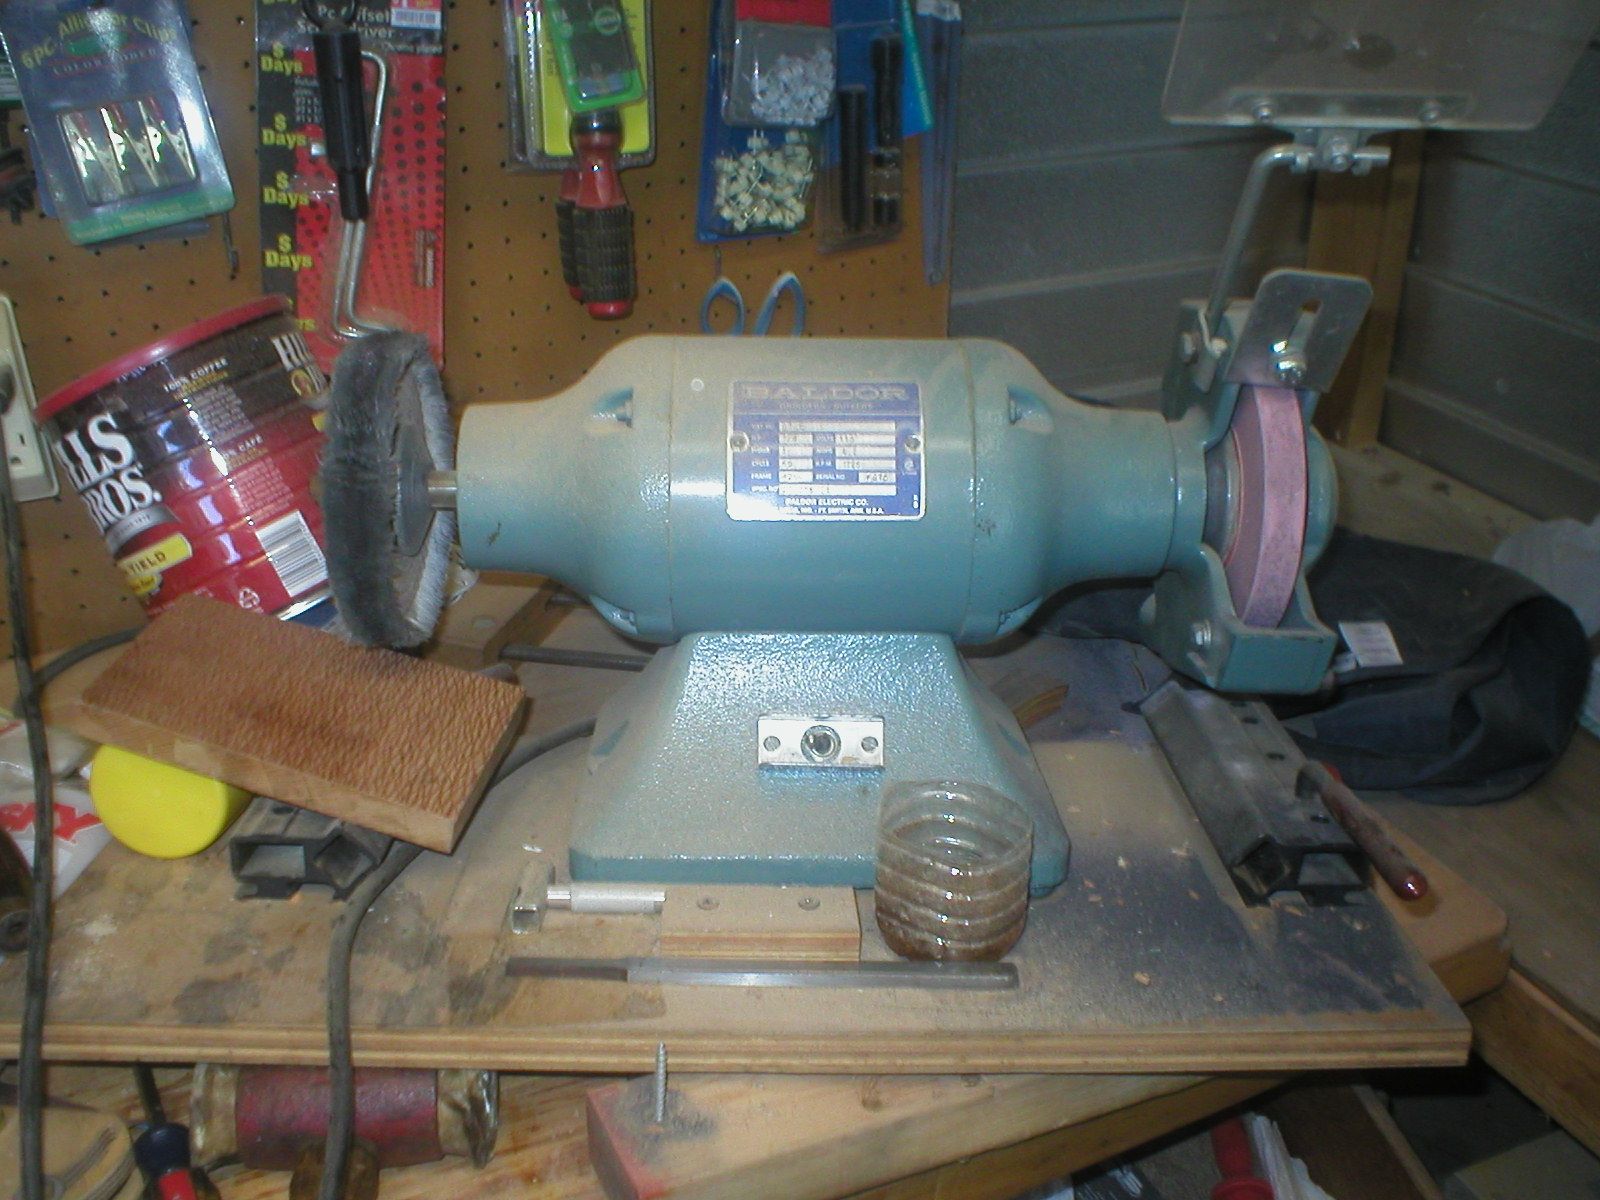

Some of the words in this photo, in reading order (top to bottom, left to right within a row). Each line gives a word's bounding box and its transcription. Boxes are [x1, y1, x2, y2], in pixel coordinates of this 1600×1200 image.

[57, 11, 128, 41] Allior
[296, 18, 394, 38] Scrdriver
[260, 55, 303, 77] Days
[262, 127, 306, 149] Days
[263, 186, 310, 209] Days
[264, 250, 313, 272] Days
[189, 356, 229, 380] COFFEE
[747, 384, 906, 401] BALDOR
[784, 498, 817, 506] BALDOR
[817, 498, 855, 506] ELECTRIC
